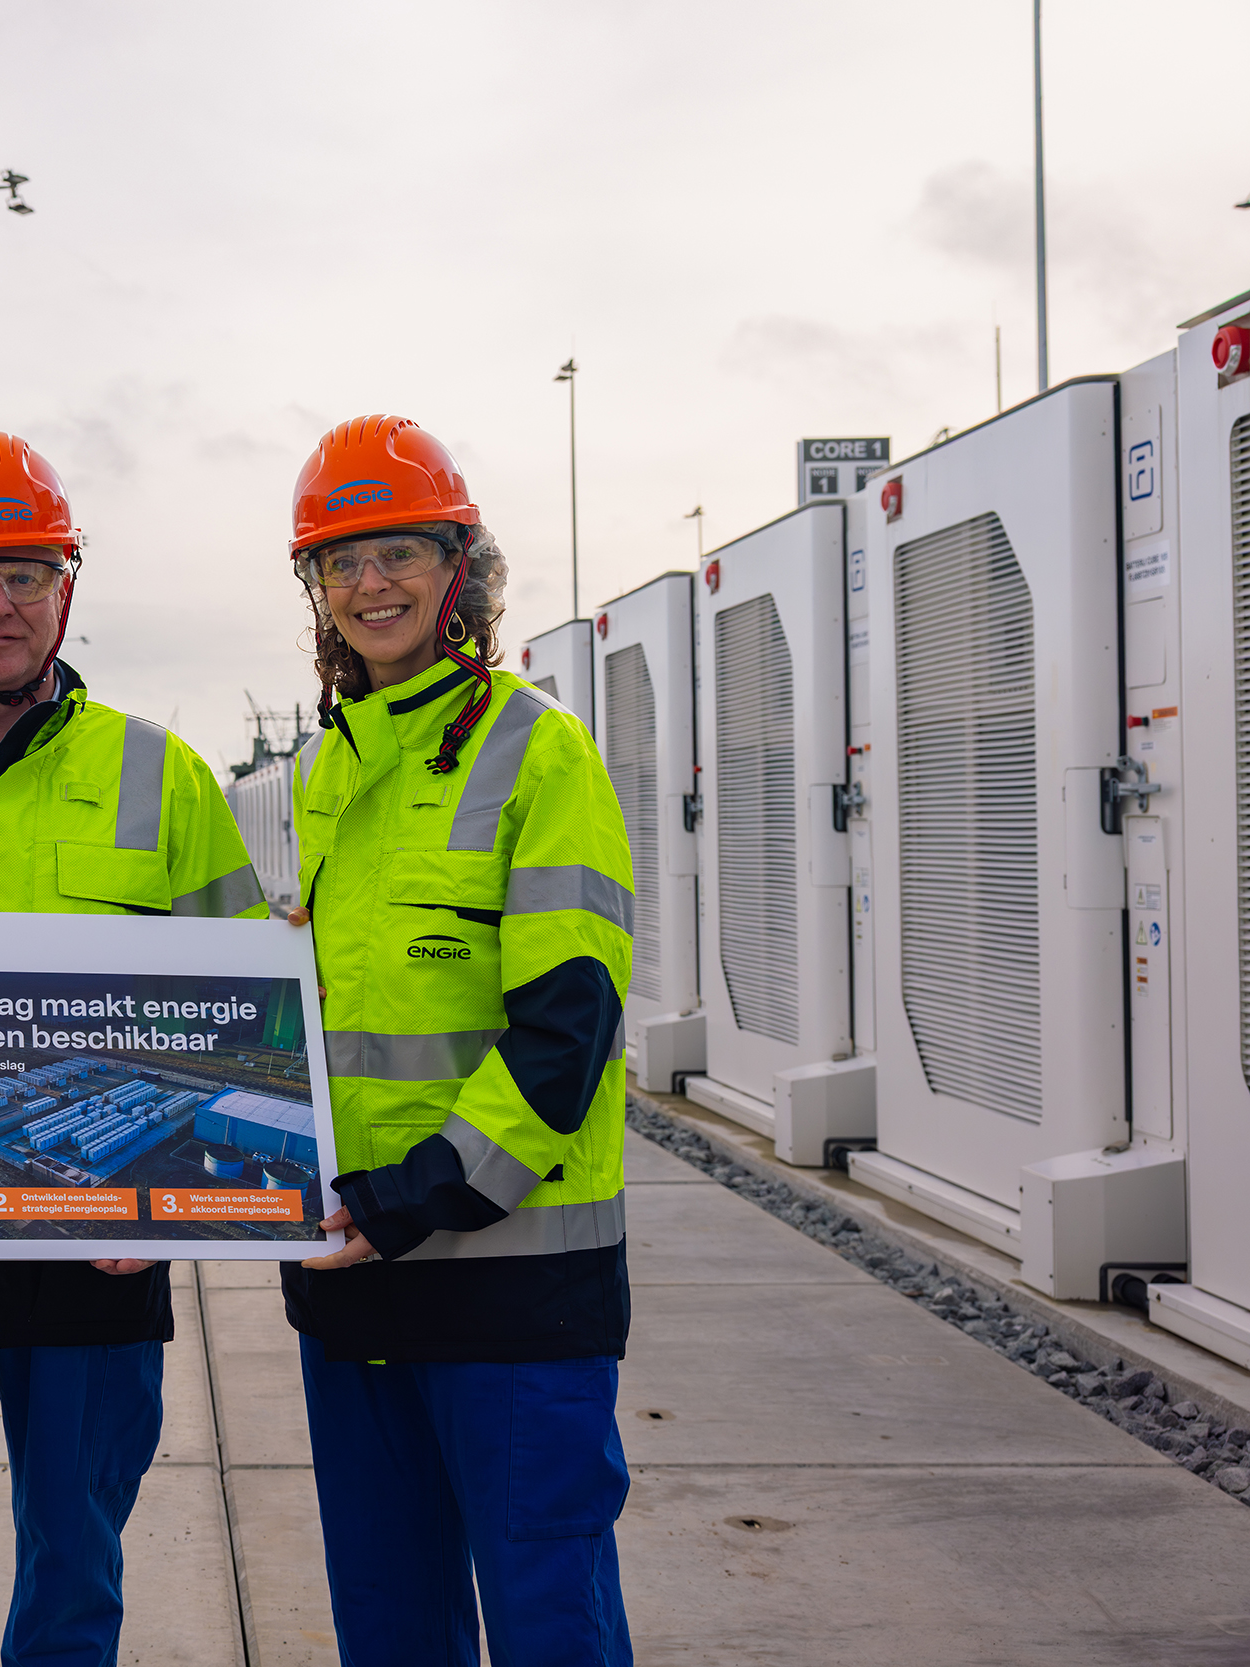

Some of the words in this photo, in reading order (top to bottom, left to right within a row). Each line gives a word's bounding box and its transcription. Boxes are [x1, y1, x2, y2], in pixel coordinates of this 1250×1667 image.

[810, 441, 868, 459] CORE
[871, 441, 882, 458] 1
[818, 477, 829, 493] 1
[41, 993, 136, 1018] maakt
[143, 996, 257, 1025] energie
[32, 1024, 218, 1051] beschikbaar
[21, 1193, 66, 1201] Ontwikkel
[85, 1193, 122, 1202] beleids-
[162, 1194, 184, 1213] 3.
[190, 1194, 214, 1202] Werk
[249, 1194, 283, 1203] Sector-
[22, 1205, 62, 1214] strategie
[64, 1205, 128, 1214] Energieopslag
[227, 1206, 291, 1215] Energieopslag
